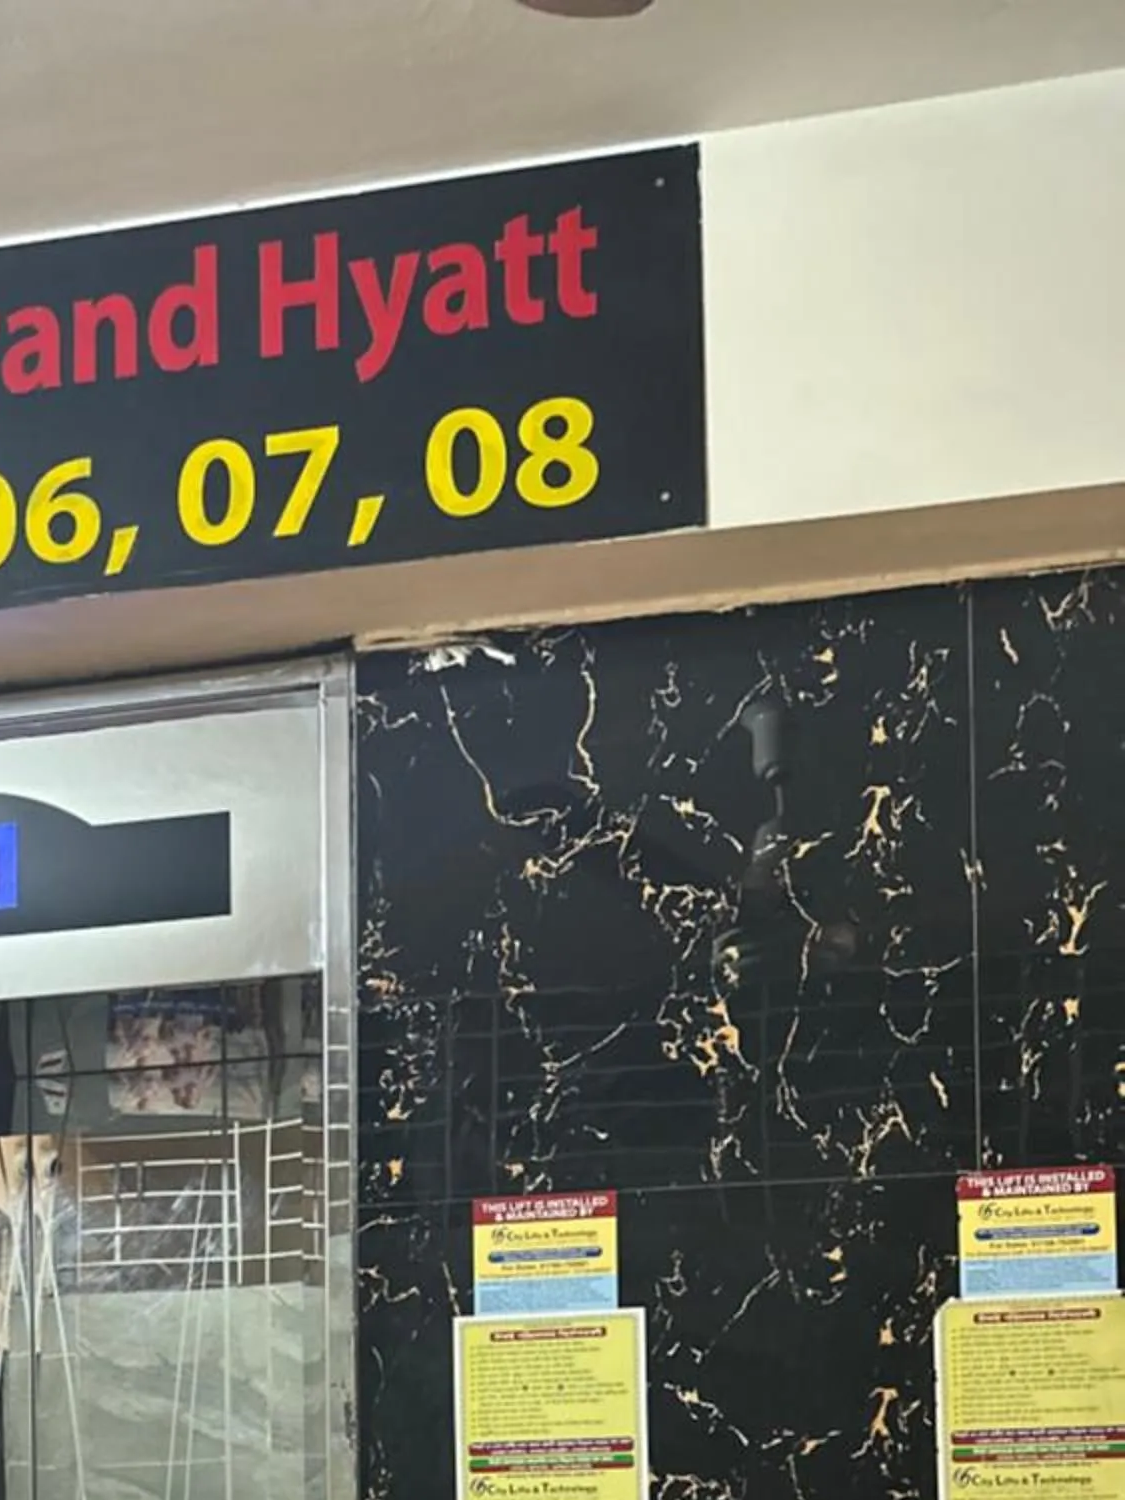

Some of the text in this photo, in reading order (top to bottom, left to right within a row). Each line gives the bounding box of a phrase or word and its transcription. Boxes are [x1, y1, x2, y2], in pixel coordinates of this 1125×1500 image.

[258, 205, 599, 383] Hyatt
[177, 424, 386, 547] 07,
[425, 396, 600, 517] 08
